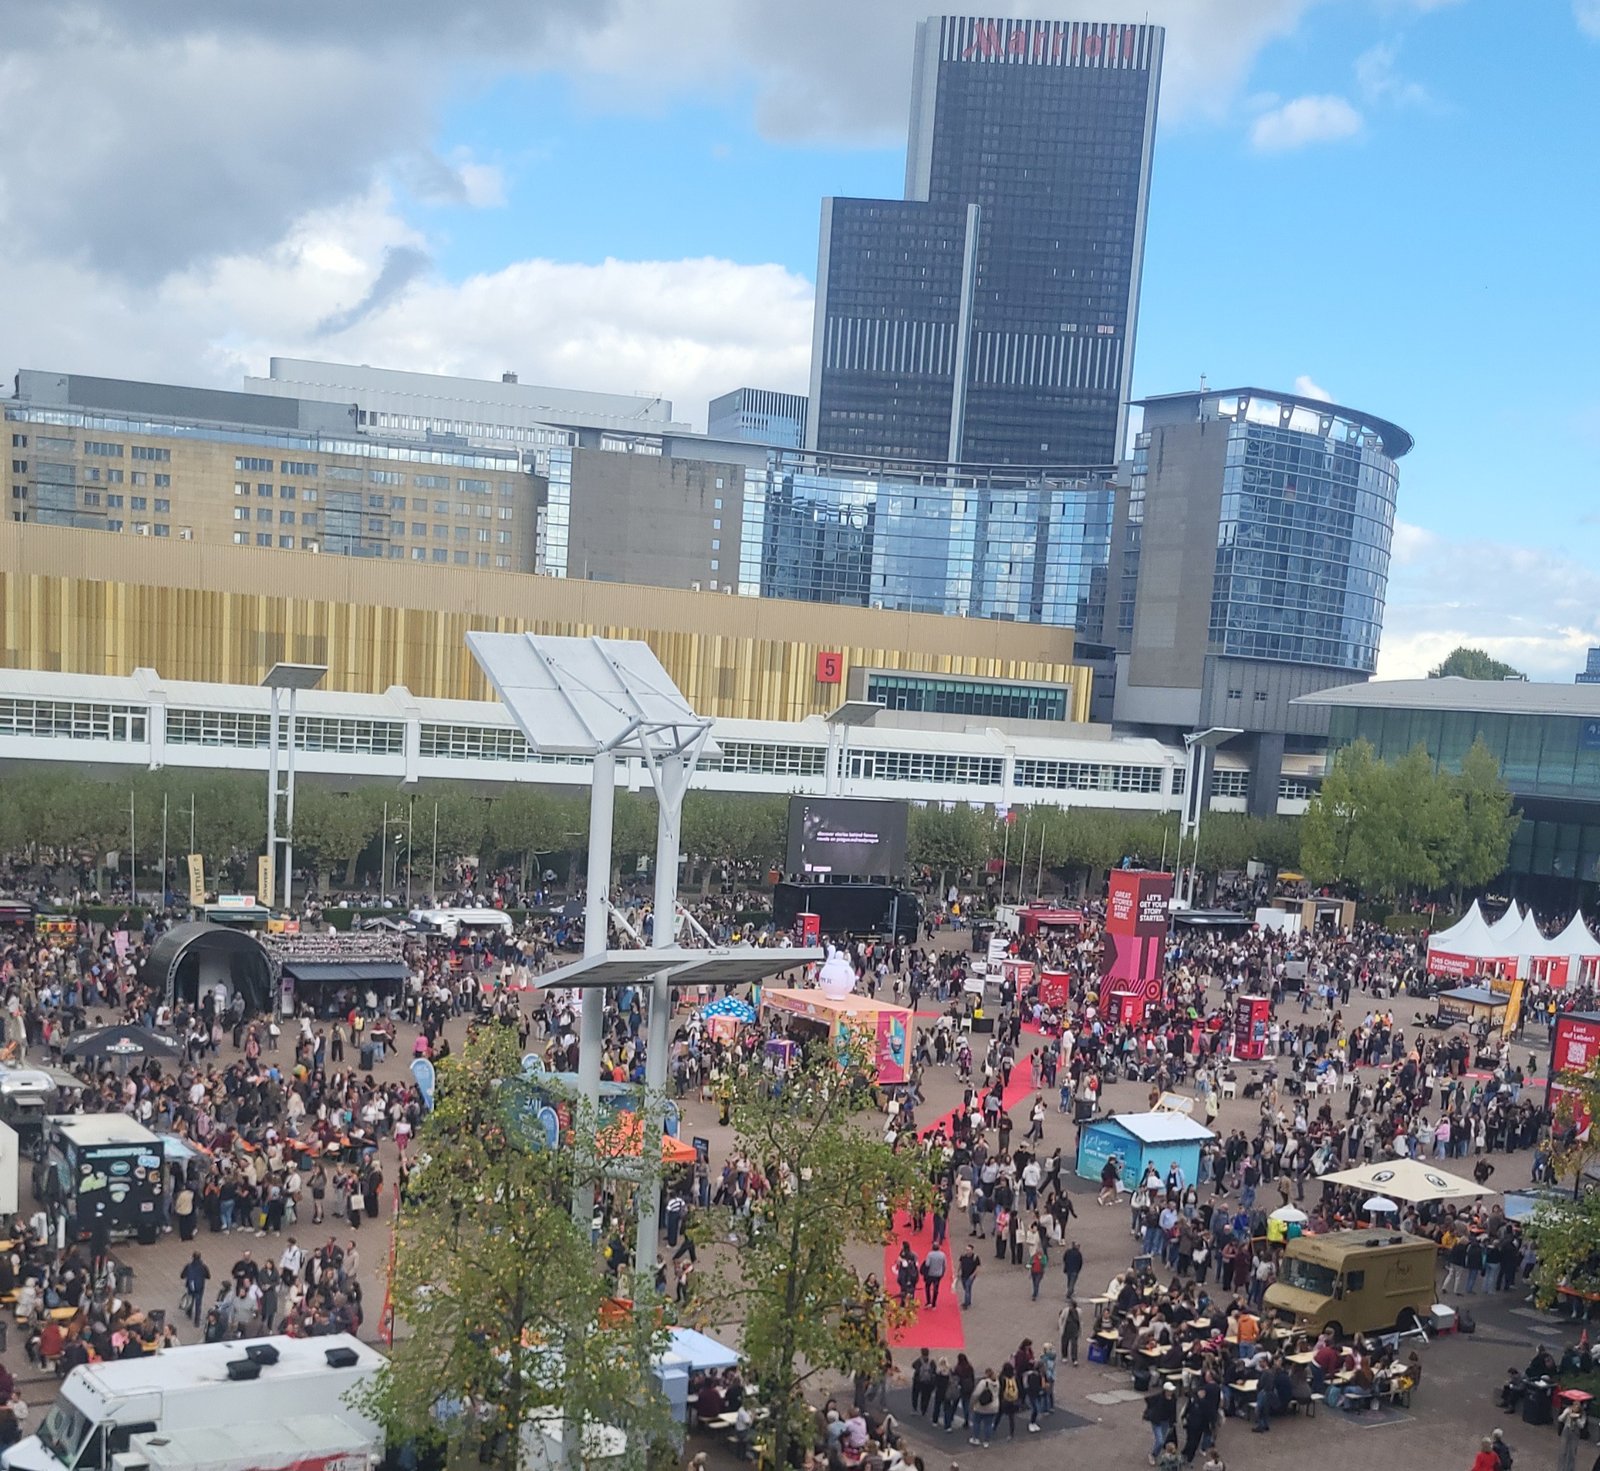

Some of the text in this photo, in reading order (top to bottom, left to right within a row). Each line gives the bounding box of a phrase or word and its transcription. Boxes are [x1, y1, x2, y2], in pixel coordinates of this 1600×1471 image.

[961, 20, 1134, 59] Marriott
[825, 658, 836, 677] 5
[1114, 891, 1132, 899] GREAT
[1112, 897, 1133, 906] STORIES
[1114, 904, 1130, 913] START
[1431, 956, 1470, 969] THIS CHANGES
